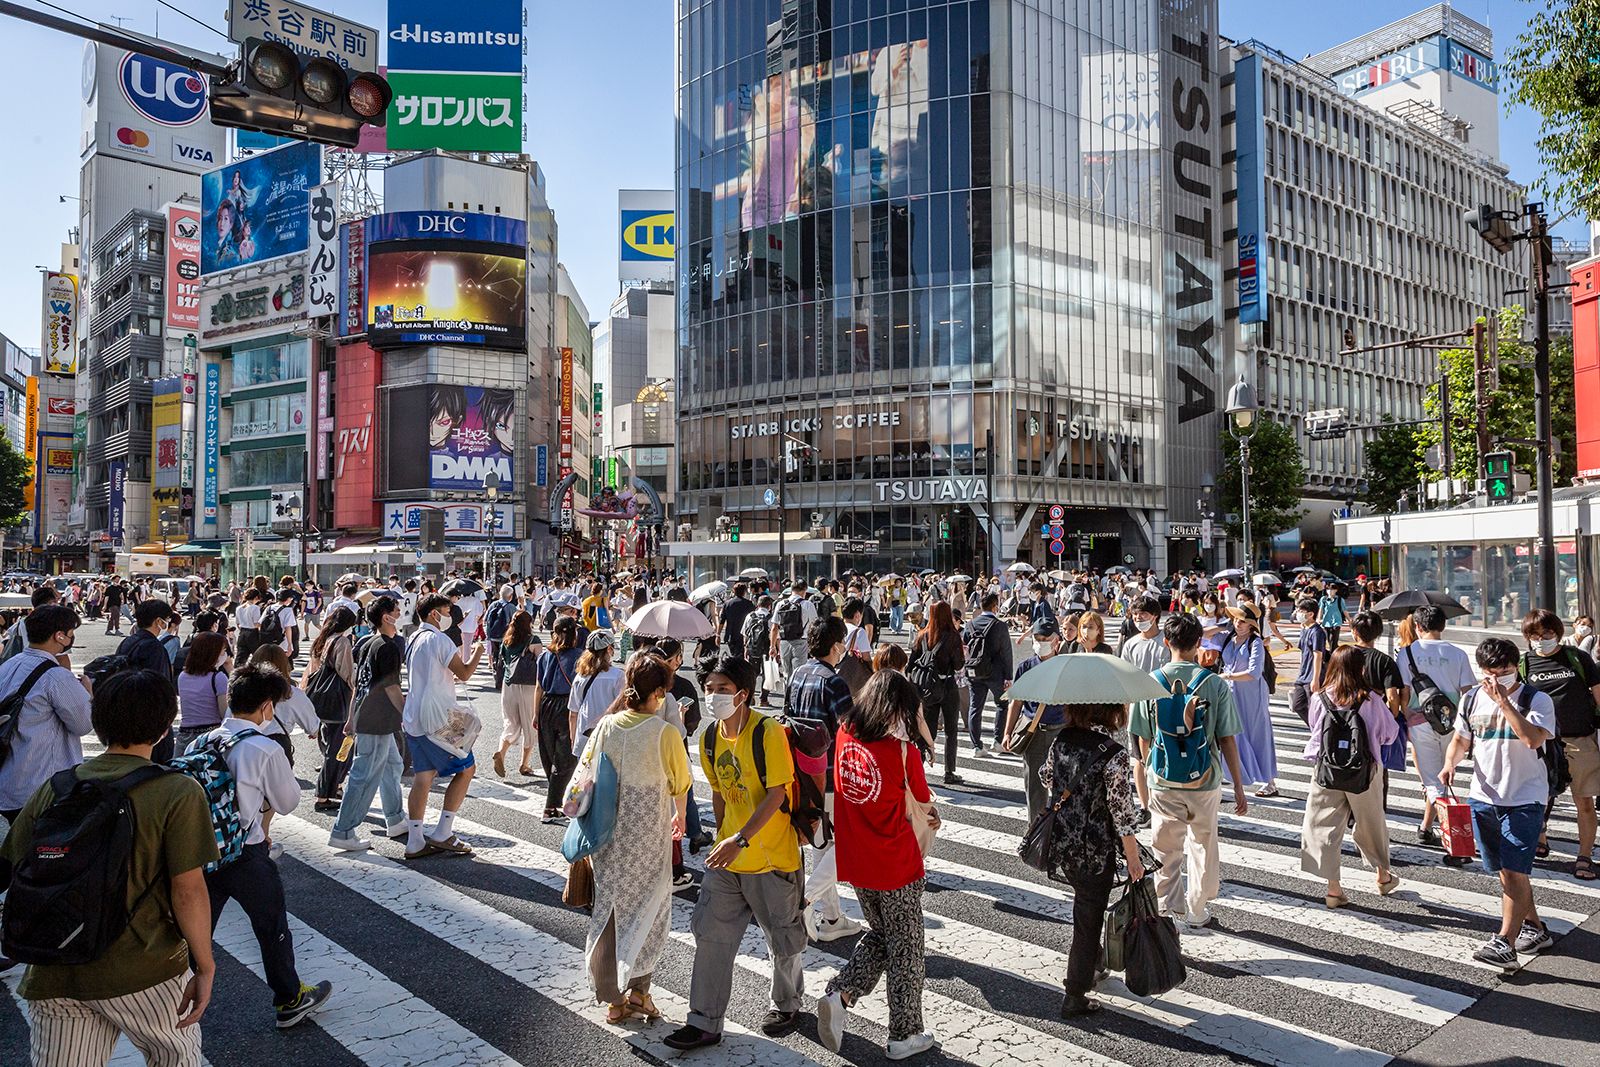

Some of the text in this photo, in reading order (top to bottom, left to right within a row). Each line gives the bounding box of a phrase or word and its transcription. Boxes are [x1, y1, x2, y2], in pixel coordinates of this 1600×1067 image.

[242, 0, 367, 57] 渋谷駅前
[389, 24, 520, 46] Hisamitsu
[131, 60, 200, 109] UC
[1342, 47, 1425, 98] SEIBU
[1451, 46, 1493, 88] SEIBU
[395, 95, 514, 127] サロンパス
[176, 144, 214, 163] VISA
[418, 215, 466, 234] DHC
[1172, 31, 1215, 424] TSUTAYA
[311, 187, 337, 312] もんじゃ
[1239, 234, 1258, 306] SEIBU
[436, 334, 464, 342] Channel
[207, 381, 218, 465] サマーフルーツギフト
[832, 411, 901, 430] COFFEE
[337, 412, 372, 478] クスリ
[432, 454, 512, 481] DMM
[875, 479, 988, 502] TSUTAYA
[1538, 670, 1576, 680] Columbia
